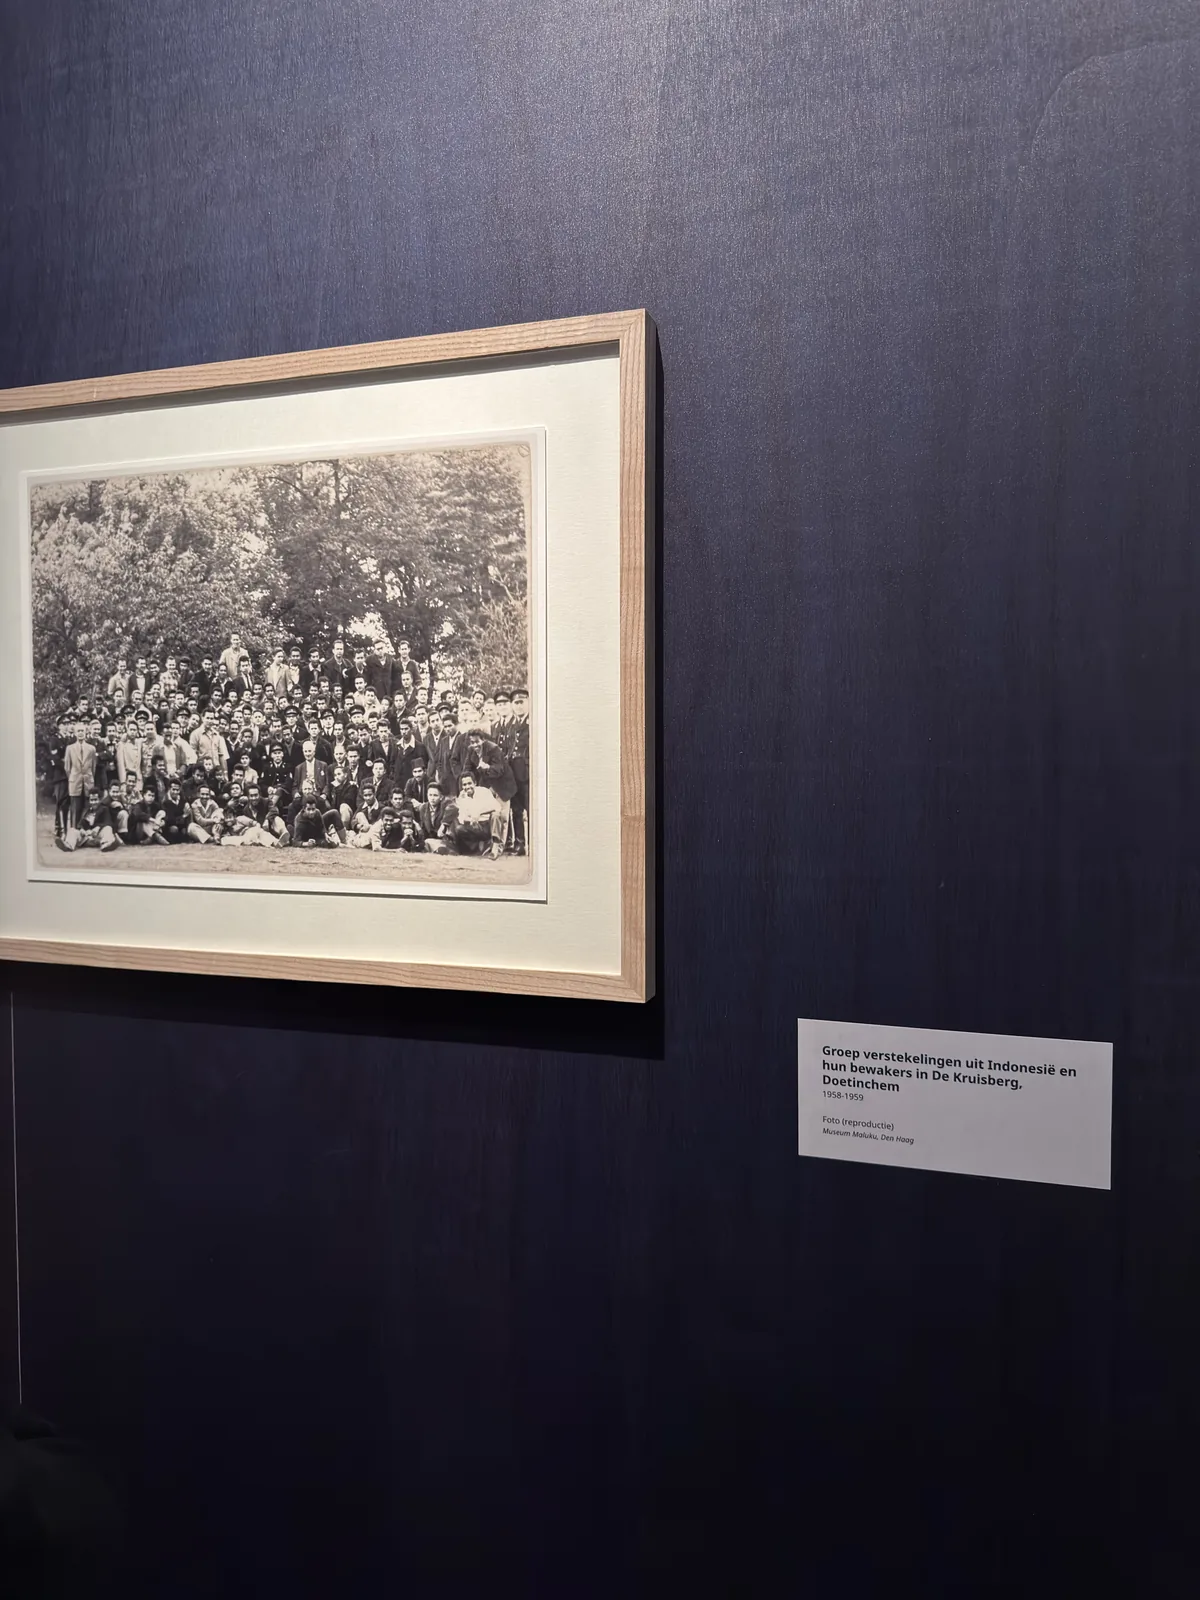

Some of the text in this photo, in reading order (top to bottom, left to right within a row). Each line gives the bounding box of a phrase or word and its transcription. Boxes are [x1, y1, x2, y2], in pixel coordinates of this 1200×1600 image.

[822, 1045, 1077, 1077] Groep verstekelingen uit Indonesië en
[822, 1060, 1023, 1090] hun bewakers in De Kruisberg,
[822, 1075, 899, 1092] Doetinchem
[822, 1090, 864, 1101] 1958-1959
[822, 1116, 894, 1131] Foto (reproductie)
[822, 1128, 914, 1145] Museum Maluku, Den Haag
